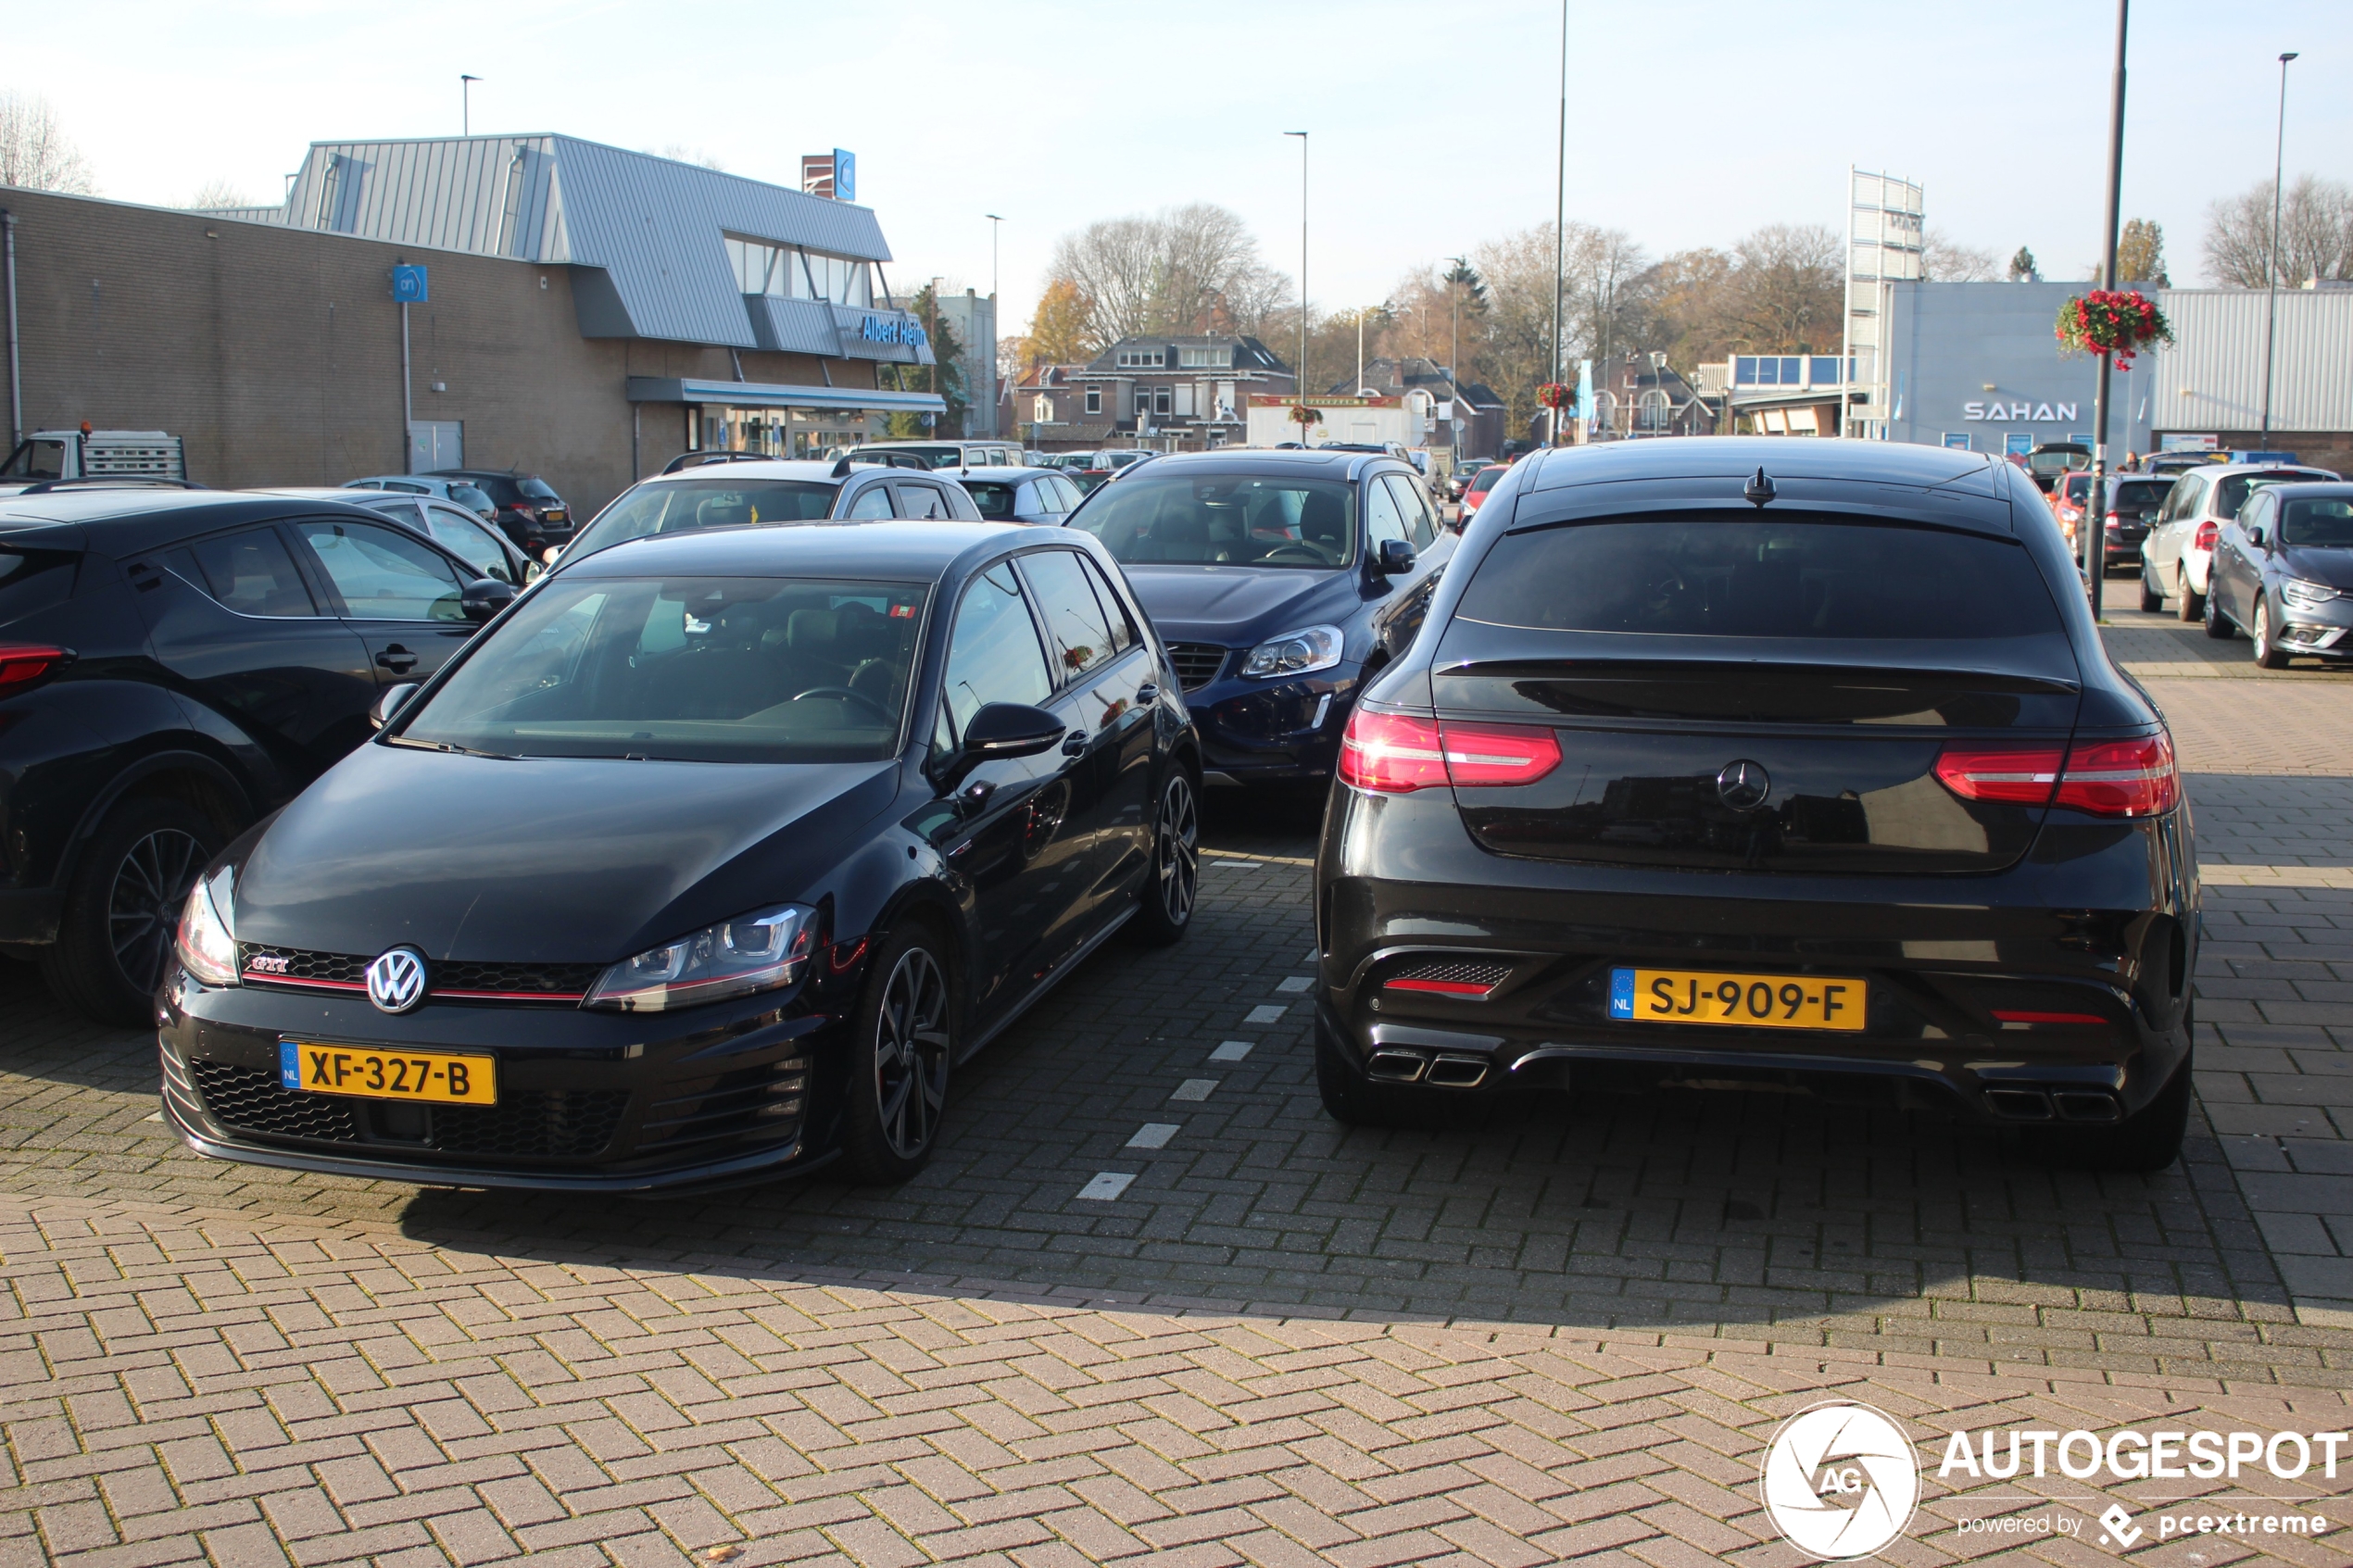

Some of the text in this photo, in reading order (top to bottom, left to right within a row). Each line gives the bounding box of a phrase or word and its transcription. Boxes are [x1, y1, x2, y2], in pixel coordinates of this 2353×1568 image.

[862, 316, 926, 349] Albert Heijn
[1963, 402, 2078, 421] SAHAN
[252, 956, 289, 972] GTI
[1614, 977, 1846, 1022] NL SJ-909-F
[283, 1051, 471, 1096] NL XF-327-B
